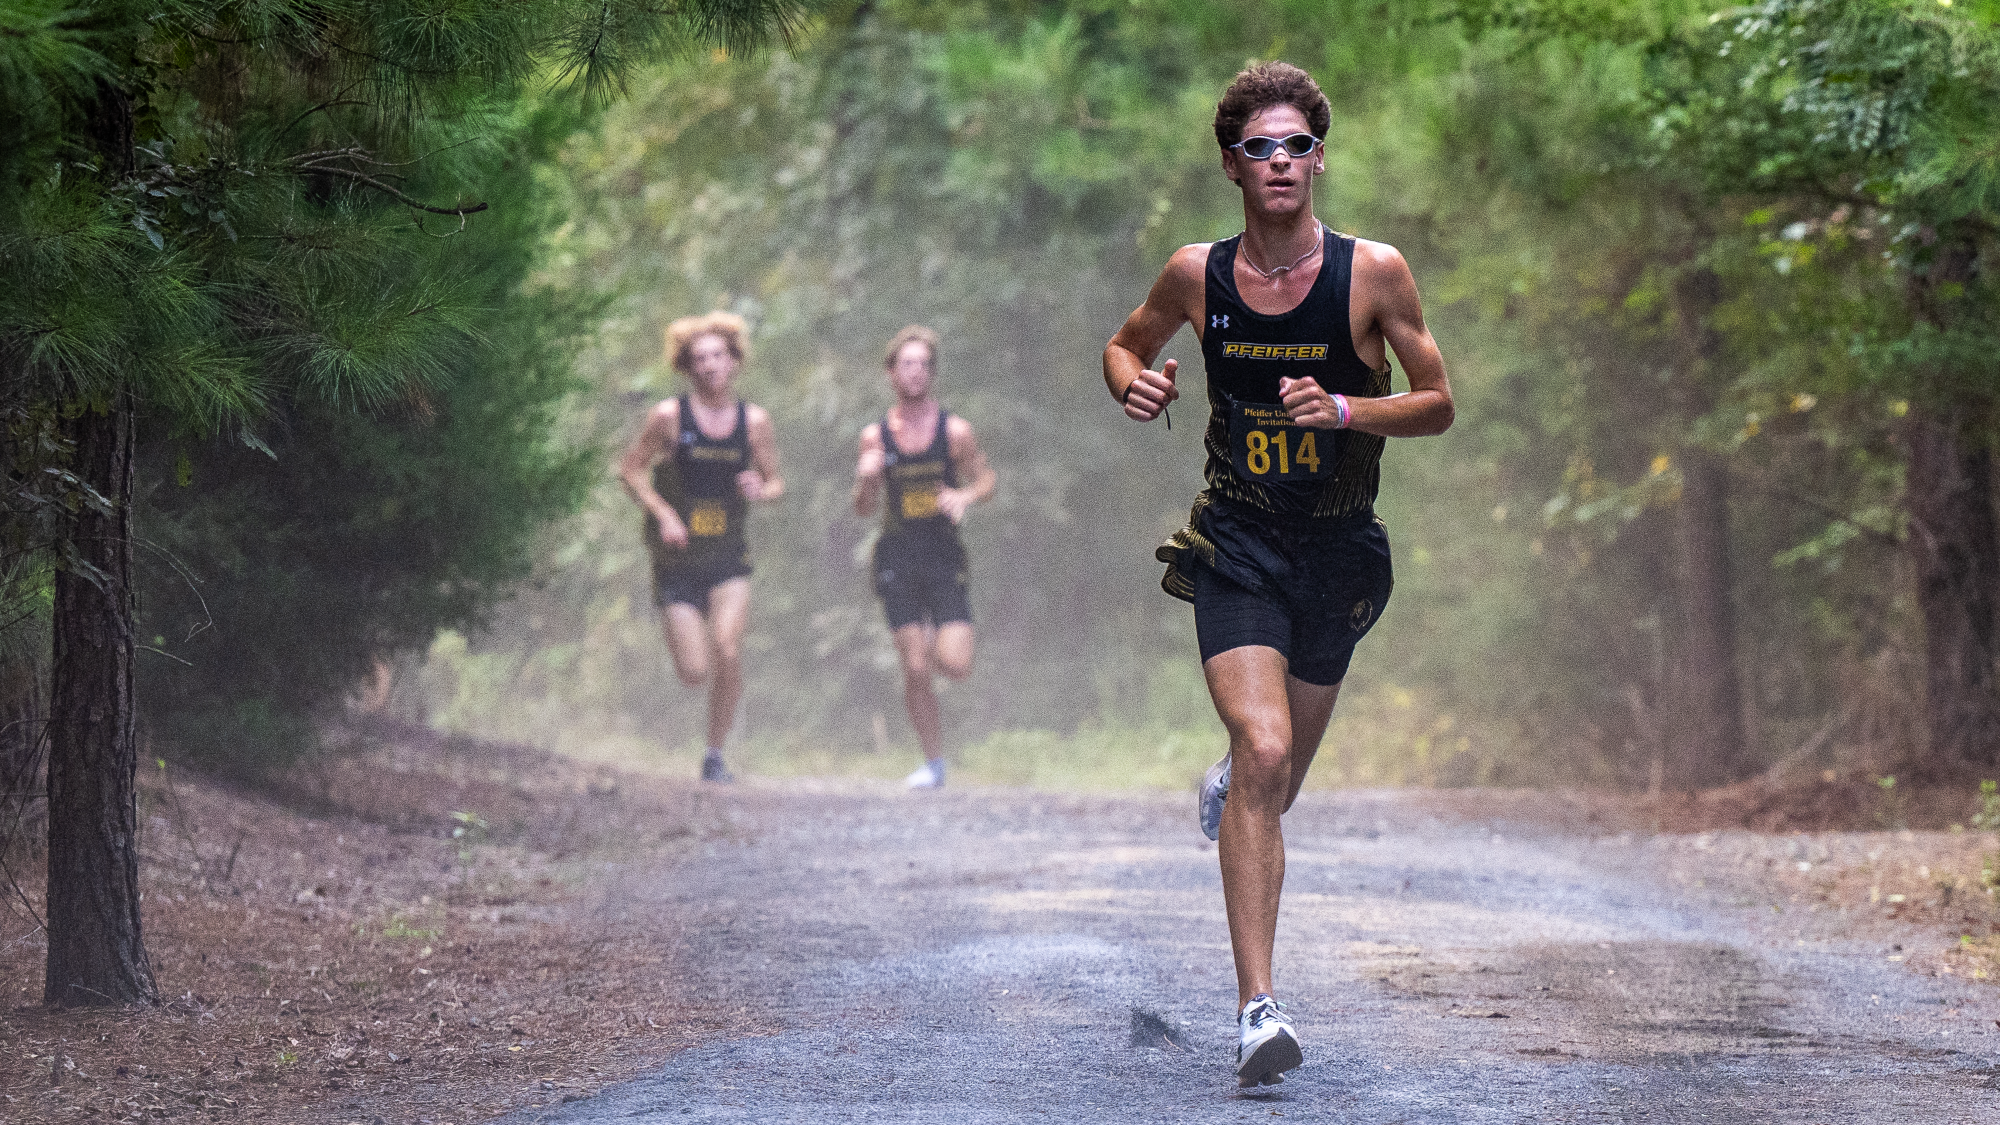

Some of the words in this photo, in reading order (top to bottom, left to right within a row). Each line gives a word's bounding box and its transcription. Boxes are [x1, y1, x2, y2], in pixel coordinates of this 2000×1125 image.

[1223, 342, 1328, 359] PFEIFFER
[1244, 408, 1273, 418] Pfeiffer
[1246, 430, 1321, 475] 814
